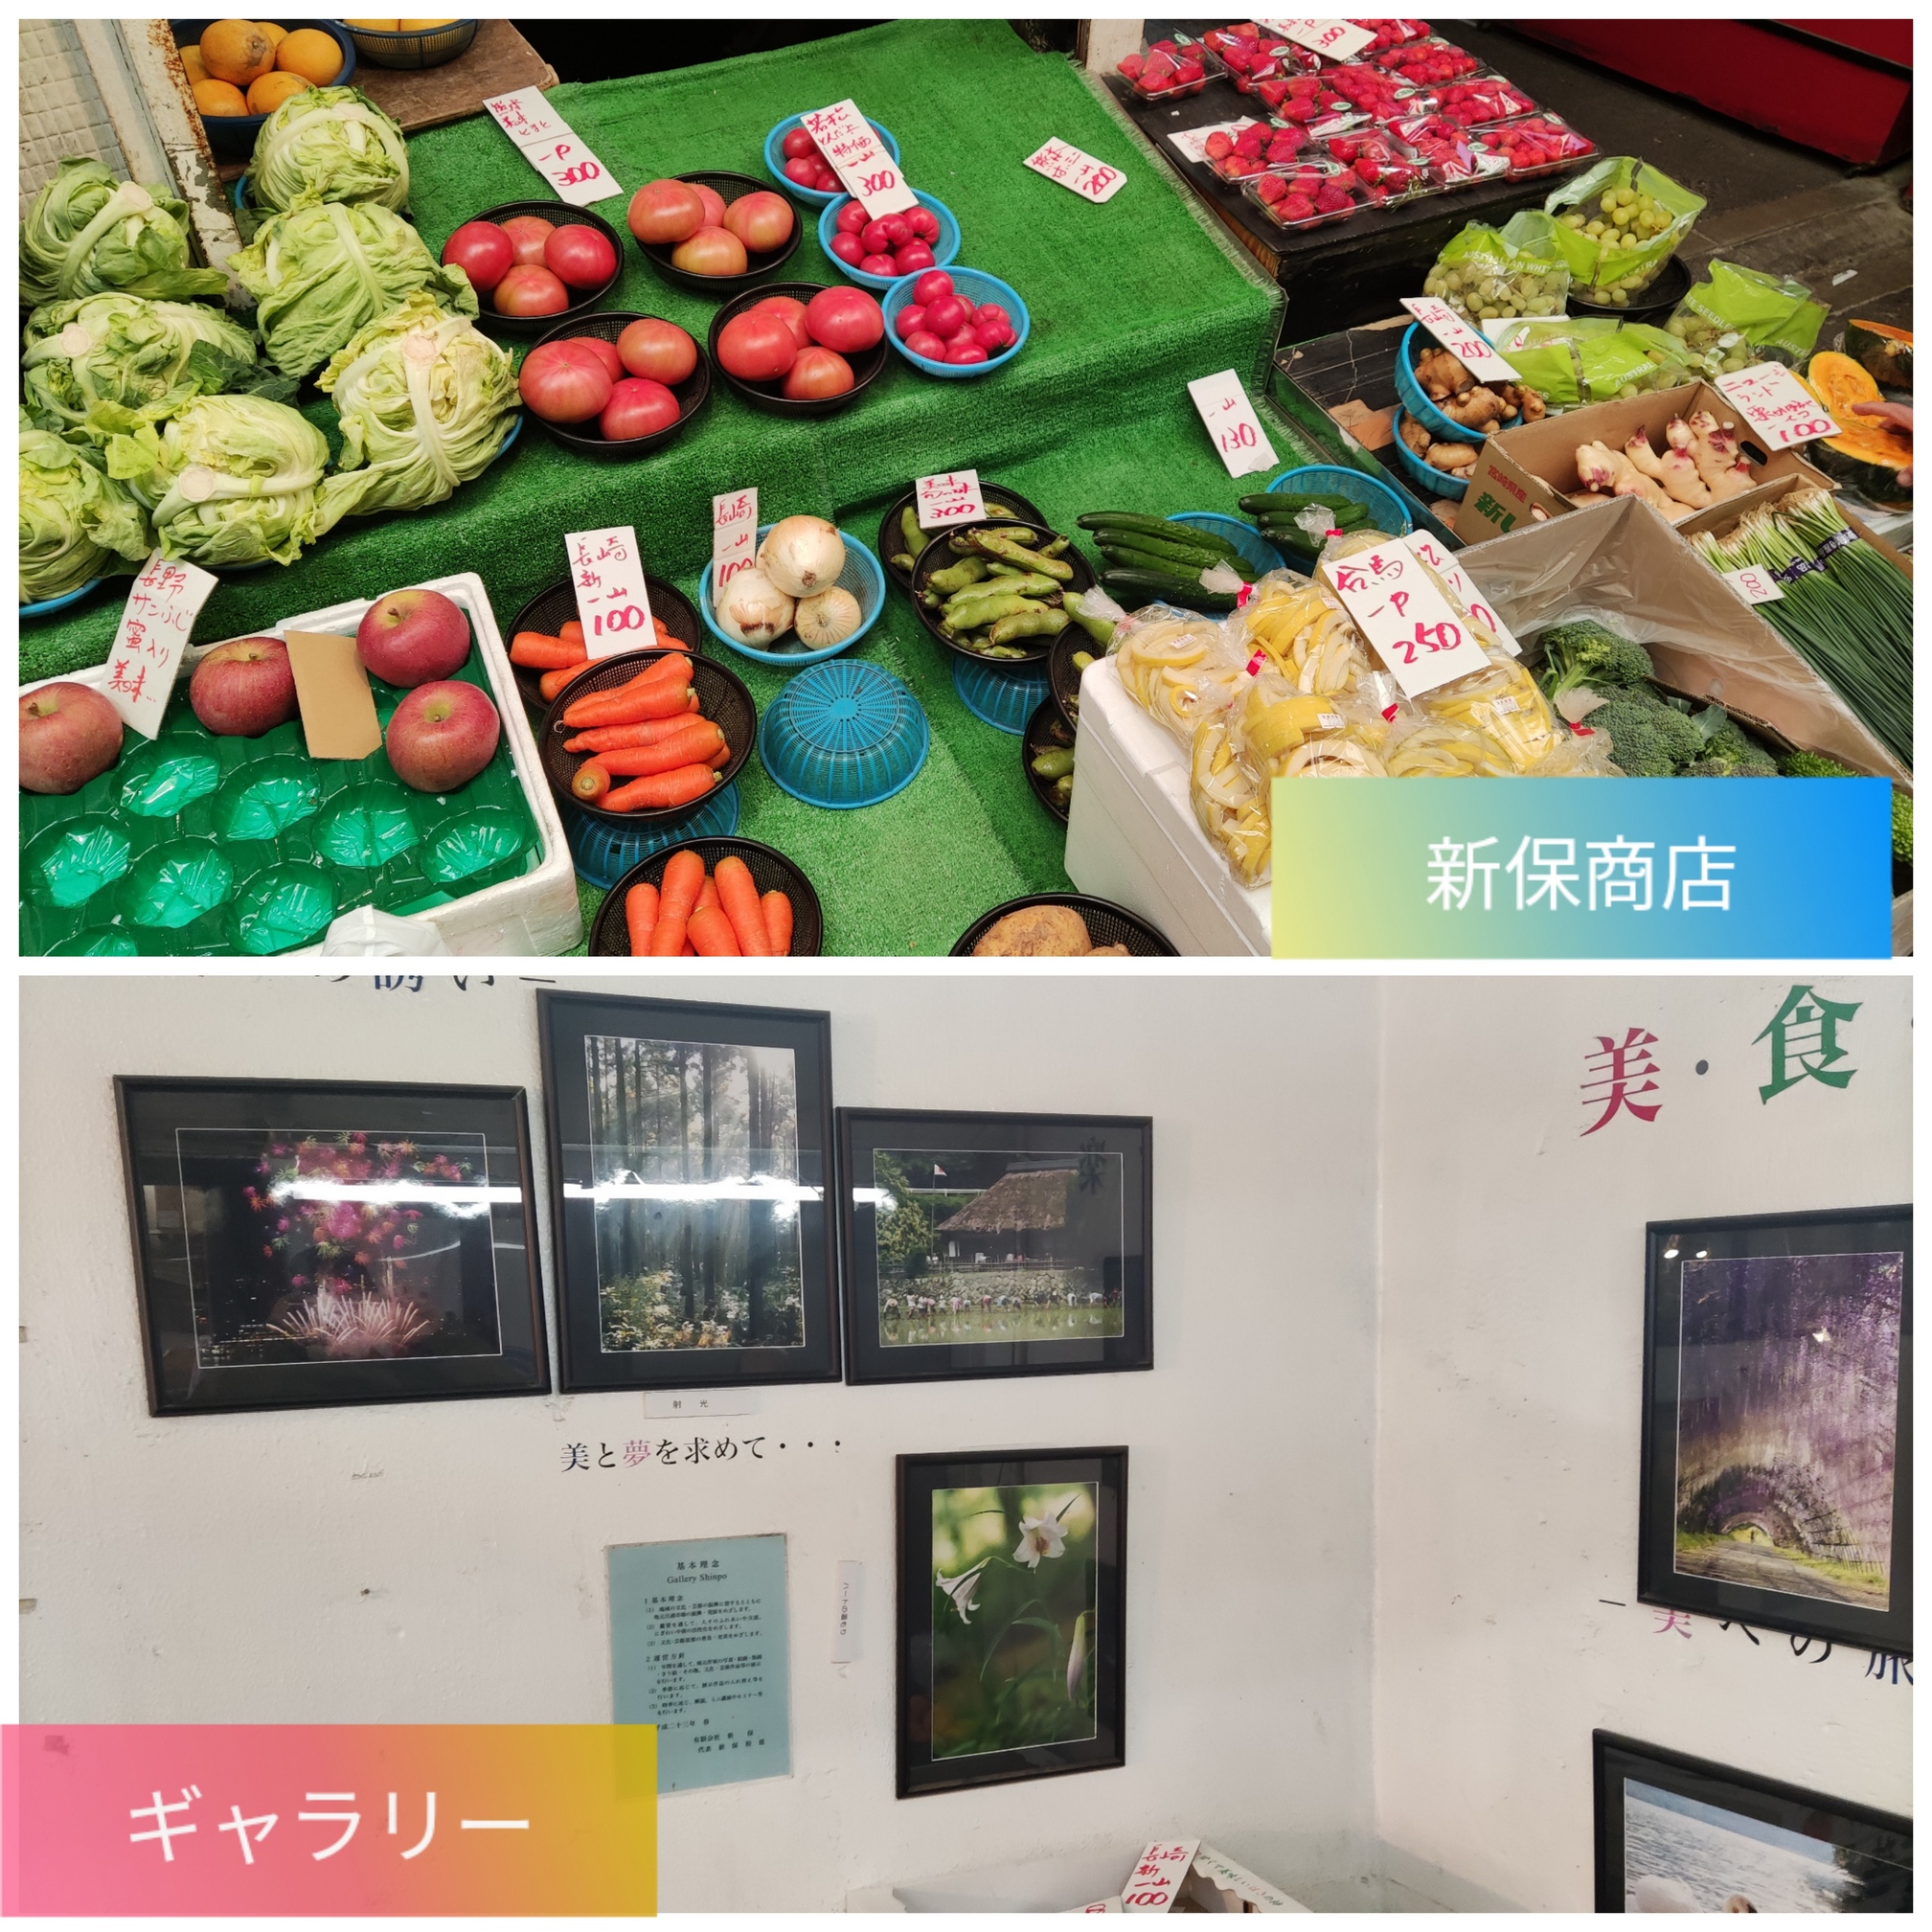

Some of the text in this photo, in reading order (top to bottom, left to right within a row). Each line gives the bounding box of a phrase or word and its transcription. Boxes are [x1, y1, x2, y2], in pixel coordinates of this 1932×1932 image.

[1311, 26, 1346, 49] 300
[552, 161, 601, 187] 300
[856, 170, 895, 196] 300
[1082, 166, 1118, 195] 200
[1450, 340, 1492, 358] 200
[1221, 422, 1257, 453] 130
[1780, 419, 1831, 443] 100
[930, 504, 975, 519] 300
[721, 534, 749, 552] 一山
[139, 558, 187, 603] 長野
[577, 569, 602, 588] 新
[586, 587, 627, 603] 一山
[133, 593, 193, 632] サンふじ
[594, 605, 646, 636] 100
[125, 619, 170, 668] 蜜入り
[1392, 622, 1462, 664] 250
[667, 1572, 727, 1584] Gallery Shinpo
[1134, 1864, 1161, 1877] 新
[1134, 1876, 1171, 1888] 一山
[1125, 1892, 1169, 1906] 100
